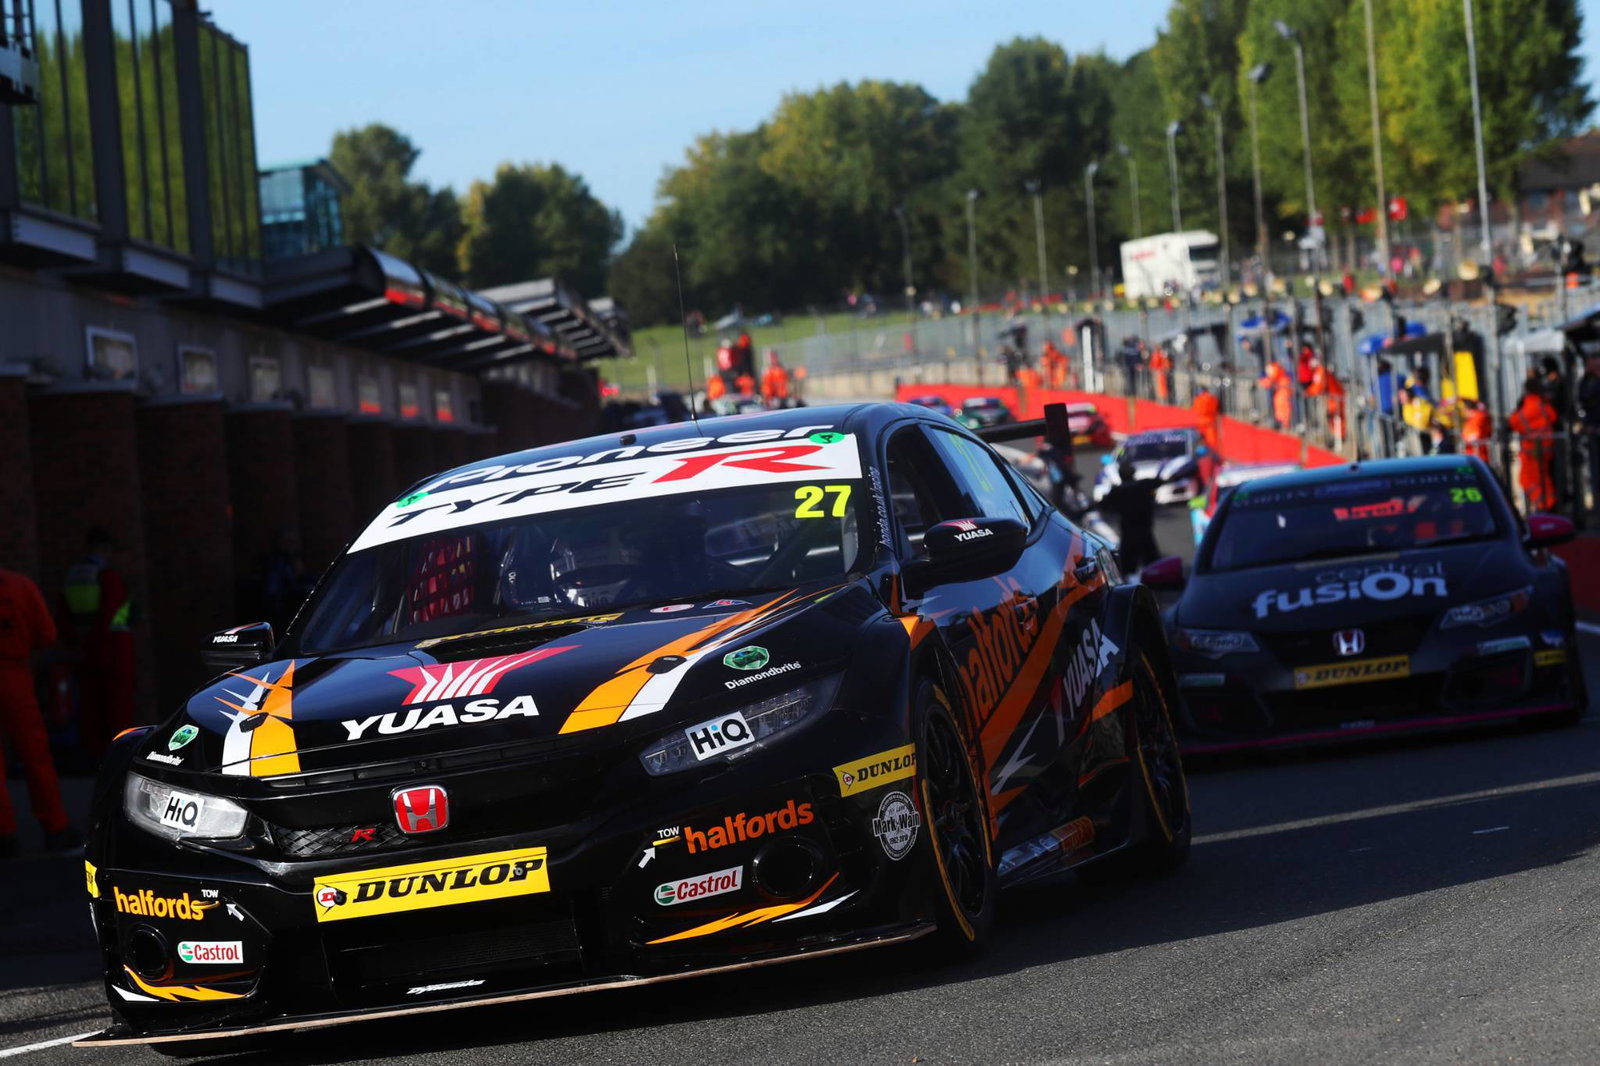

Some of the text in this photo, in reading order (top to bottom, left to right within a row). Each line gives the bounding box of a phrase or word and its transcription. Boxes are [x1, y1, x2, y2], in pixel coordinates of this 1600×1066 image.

[387, 445, 836, 529] TYPE R
[795, 485, 852, 518] 27
[954, 528, 994, 542] YUASA
[724, 662, 800, 690] Diamondbrite
[1063, 617, 1120, 720] YUASA
[1314, 660, 1408, 681] DUNLOP
[341, 695, 540, 741] YUASA
[690, 719, 750, 755] HiQ
[164, 797, 199, 827] HiQ
[684, 800, 814, 854] halfords
[657, 826, 680, 839] TOW
[201, 889, 219, 898] TOW
[352, 858, 544, 903] DUNLOP
[677, 870, 738, 900] Castrol
[113, 886, 204, 921] halfords
[194, 944, 240, 961] Castrol
